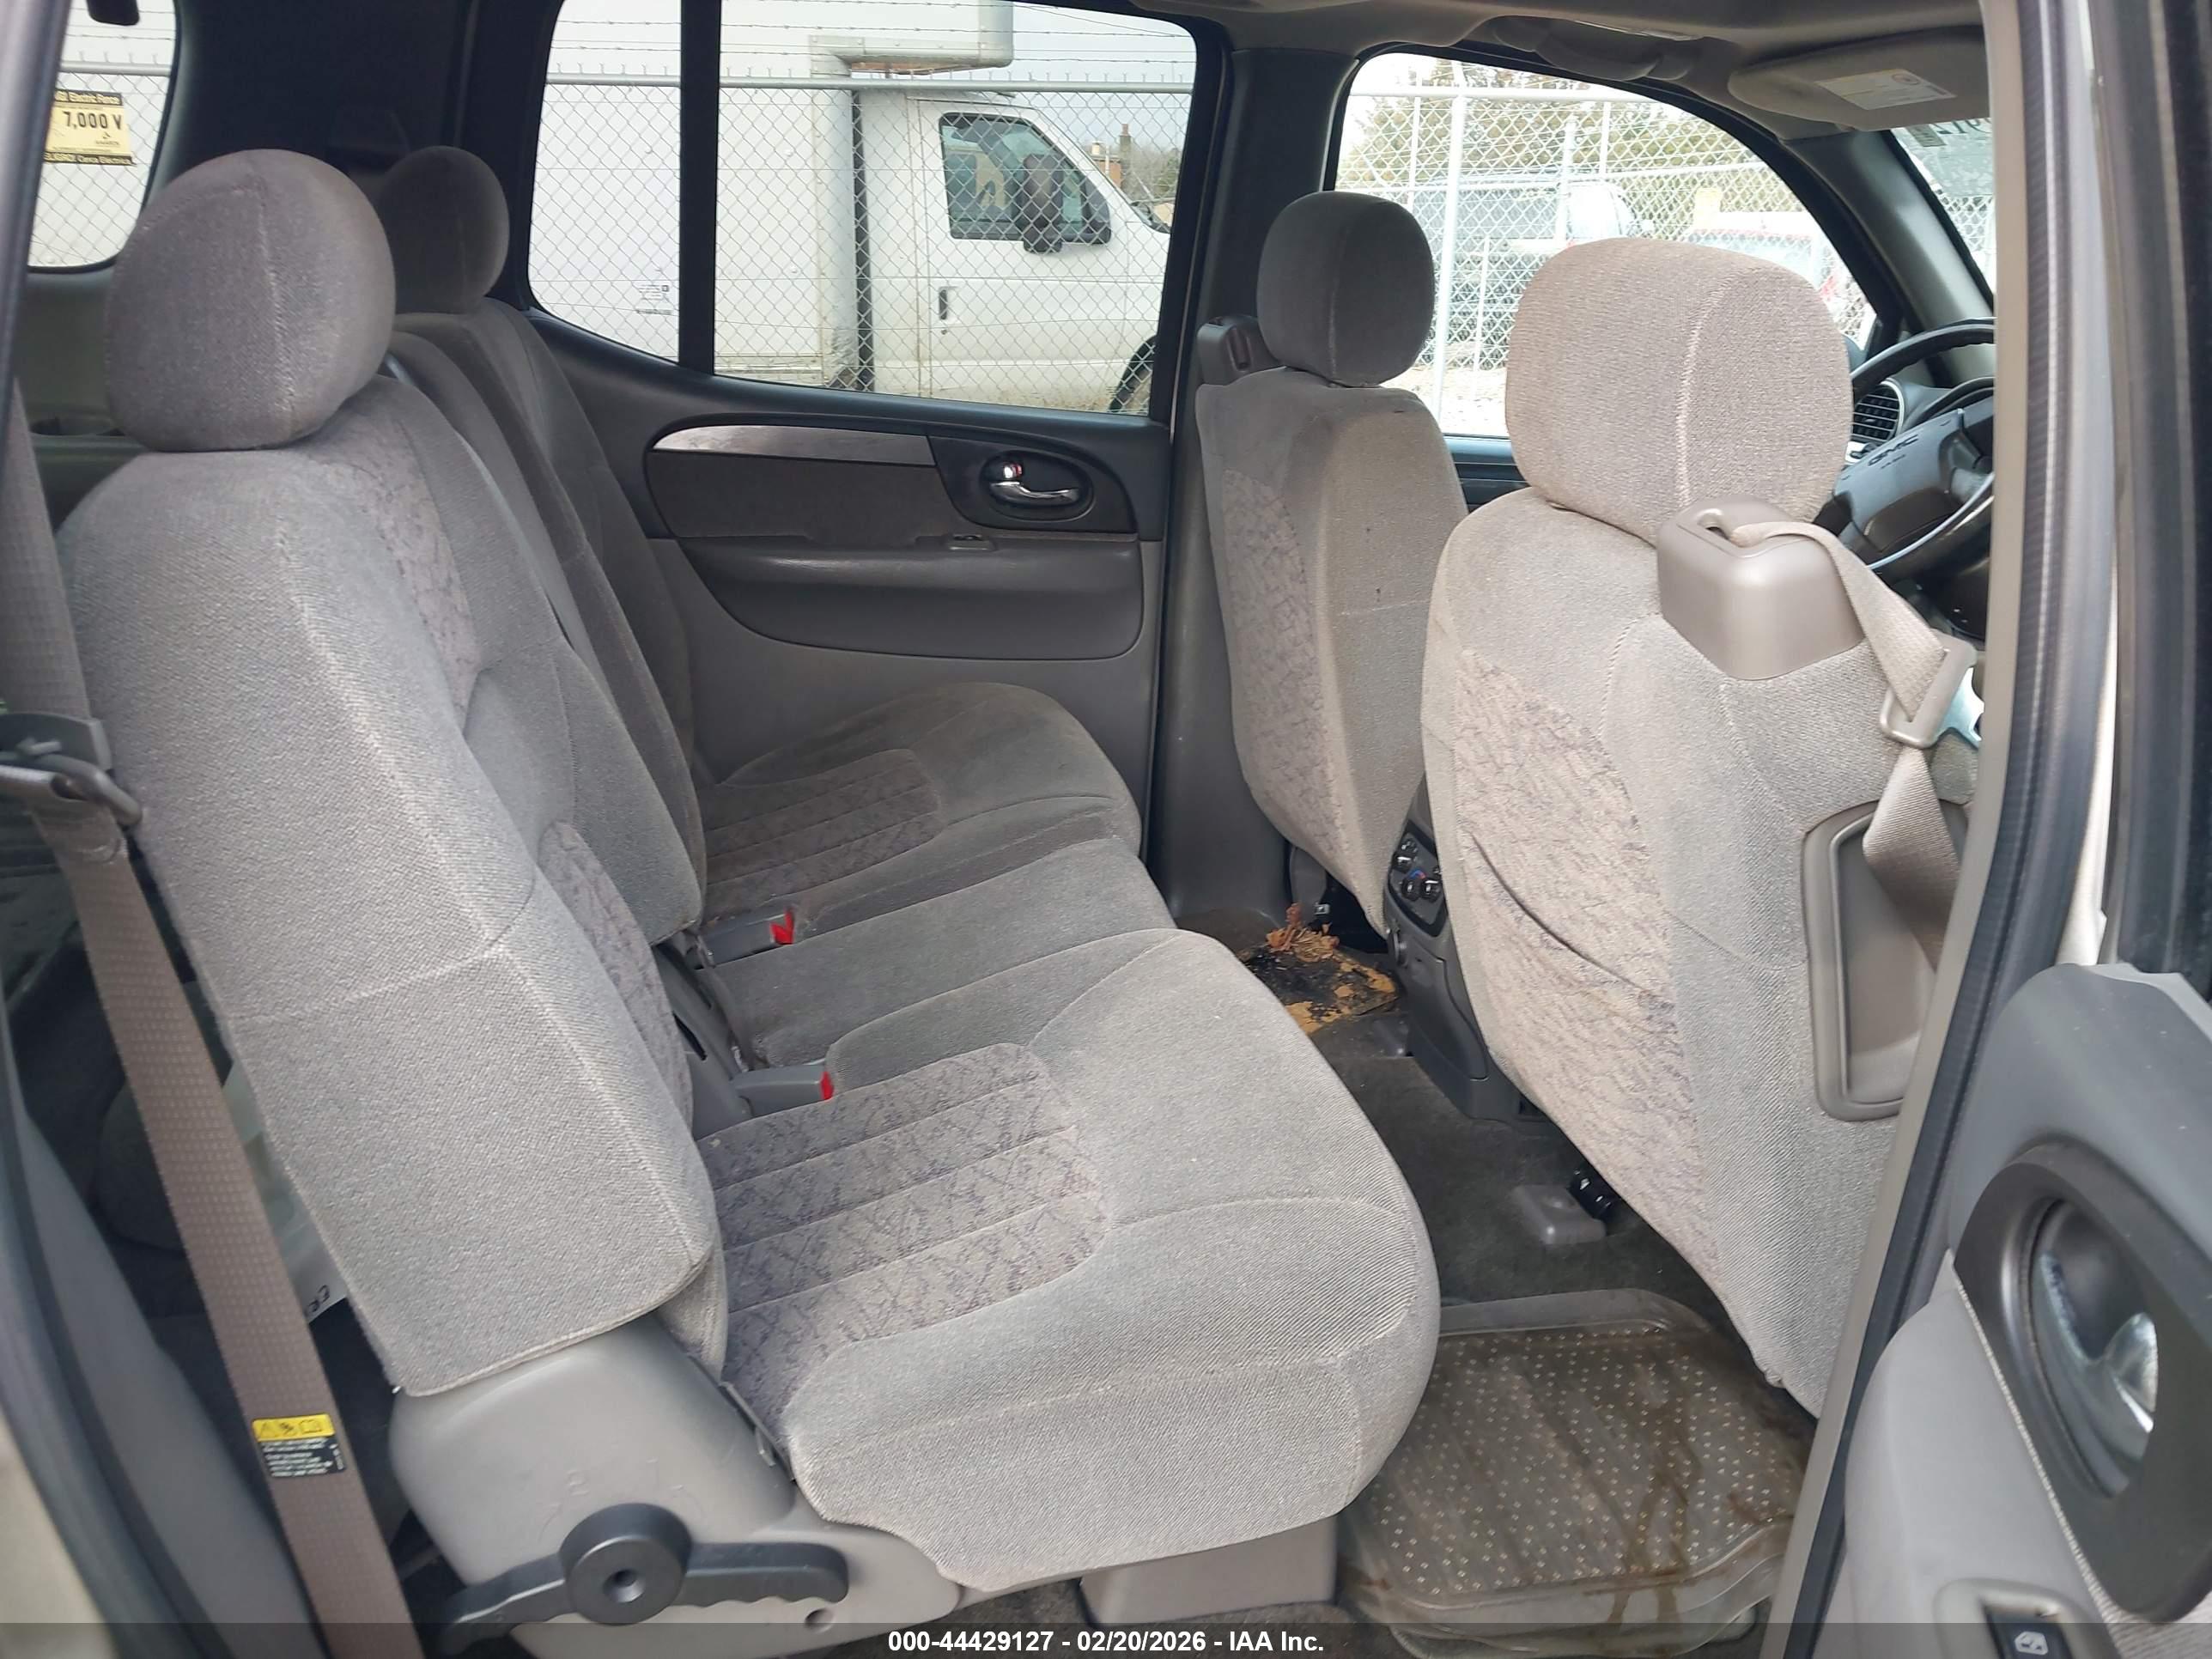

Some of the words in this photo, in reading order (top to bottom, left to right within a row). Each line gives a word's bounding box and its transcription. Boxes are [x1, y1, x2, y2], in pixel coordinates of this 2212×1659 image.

[63, 111, 108, 129] 7,000
[112, 113, 122, 130] V
[1868, 434, 1919, 466] GMC
